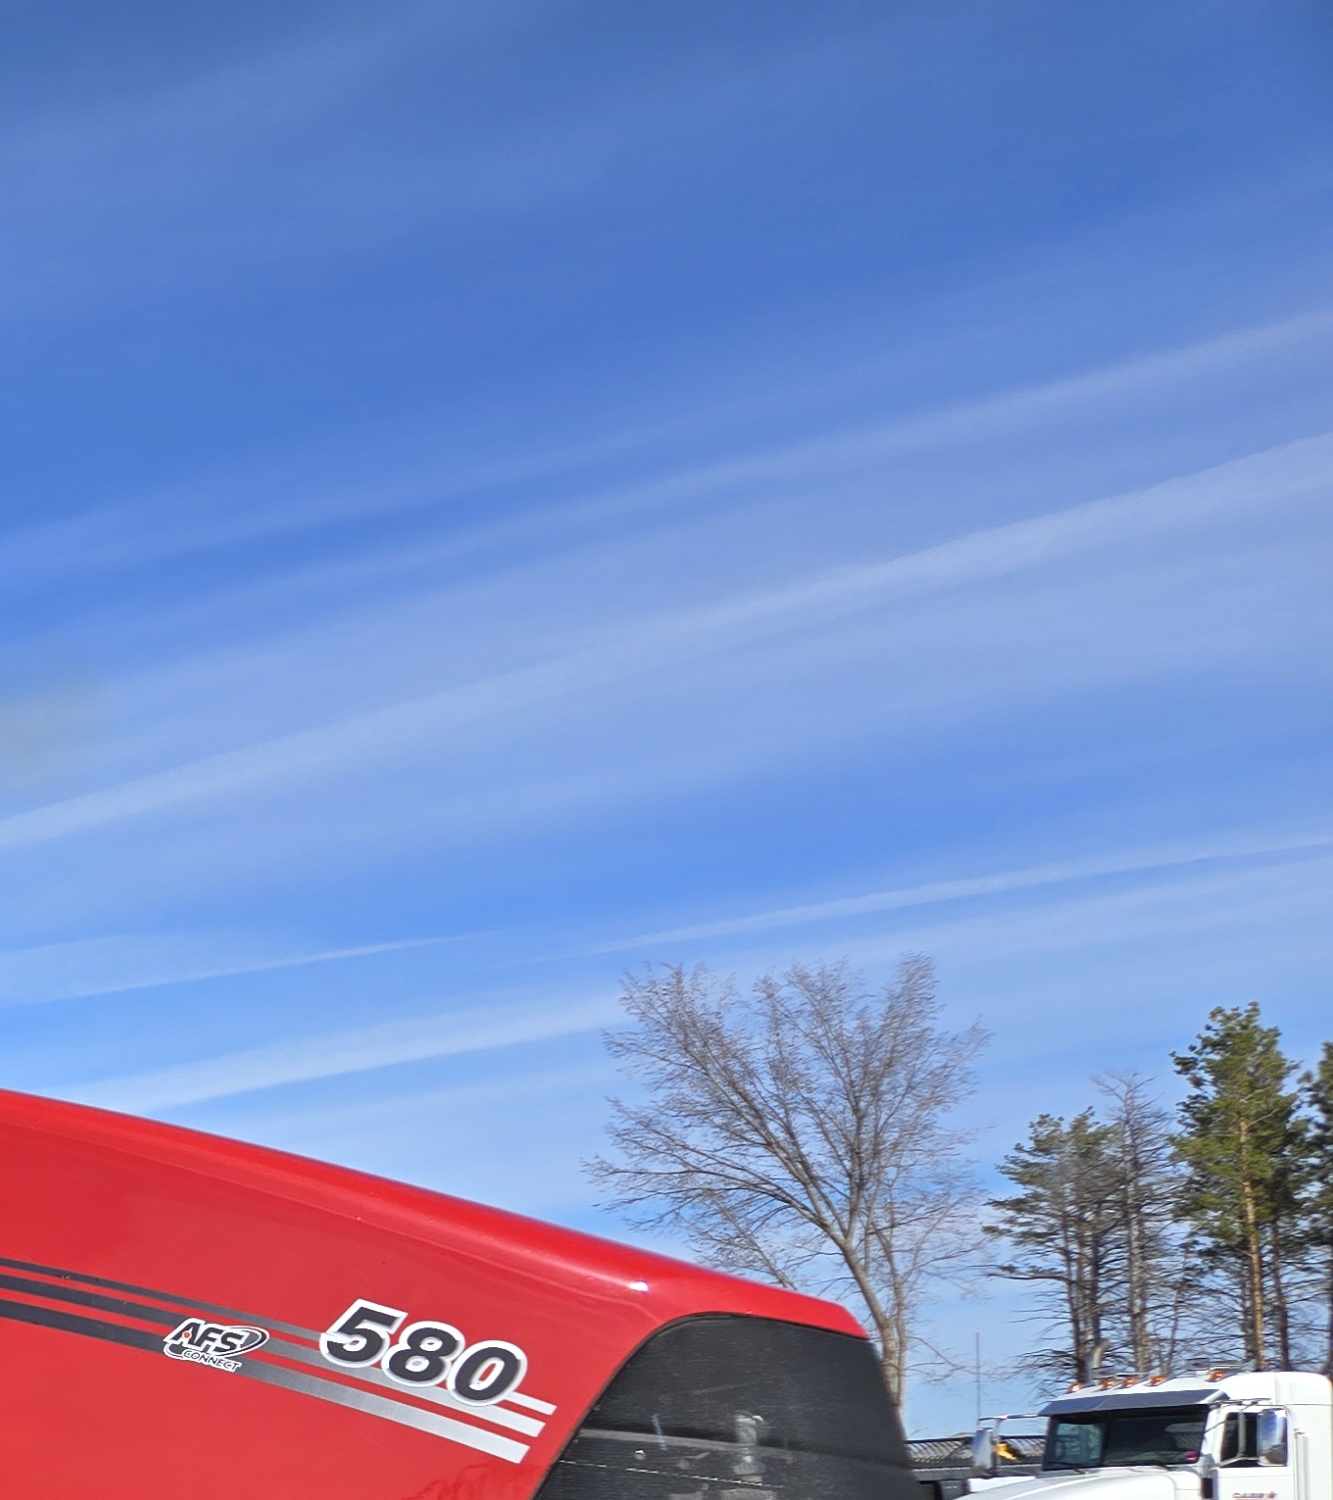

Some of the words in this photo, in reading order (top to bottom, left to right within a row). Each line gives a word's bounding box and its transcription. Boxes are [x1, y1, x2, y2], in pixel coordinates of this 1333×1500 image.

[170, 1321, 245, 1353] AFS
[320, 1299, 528, 1407] 580
[182, 1349, 241, 1371] CONNECT
